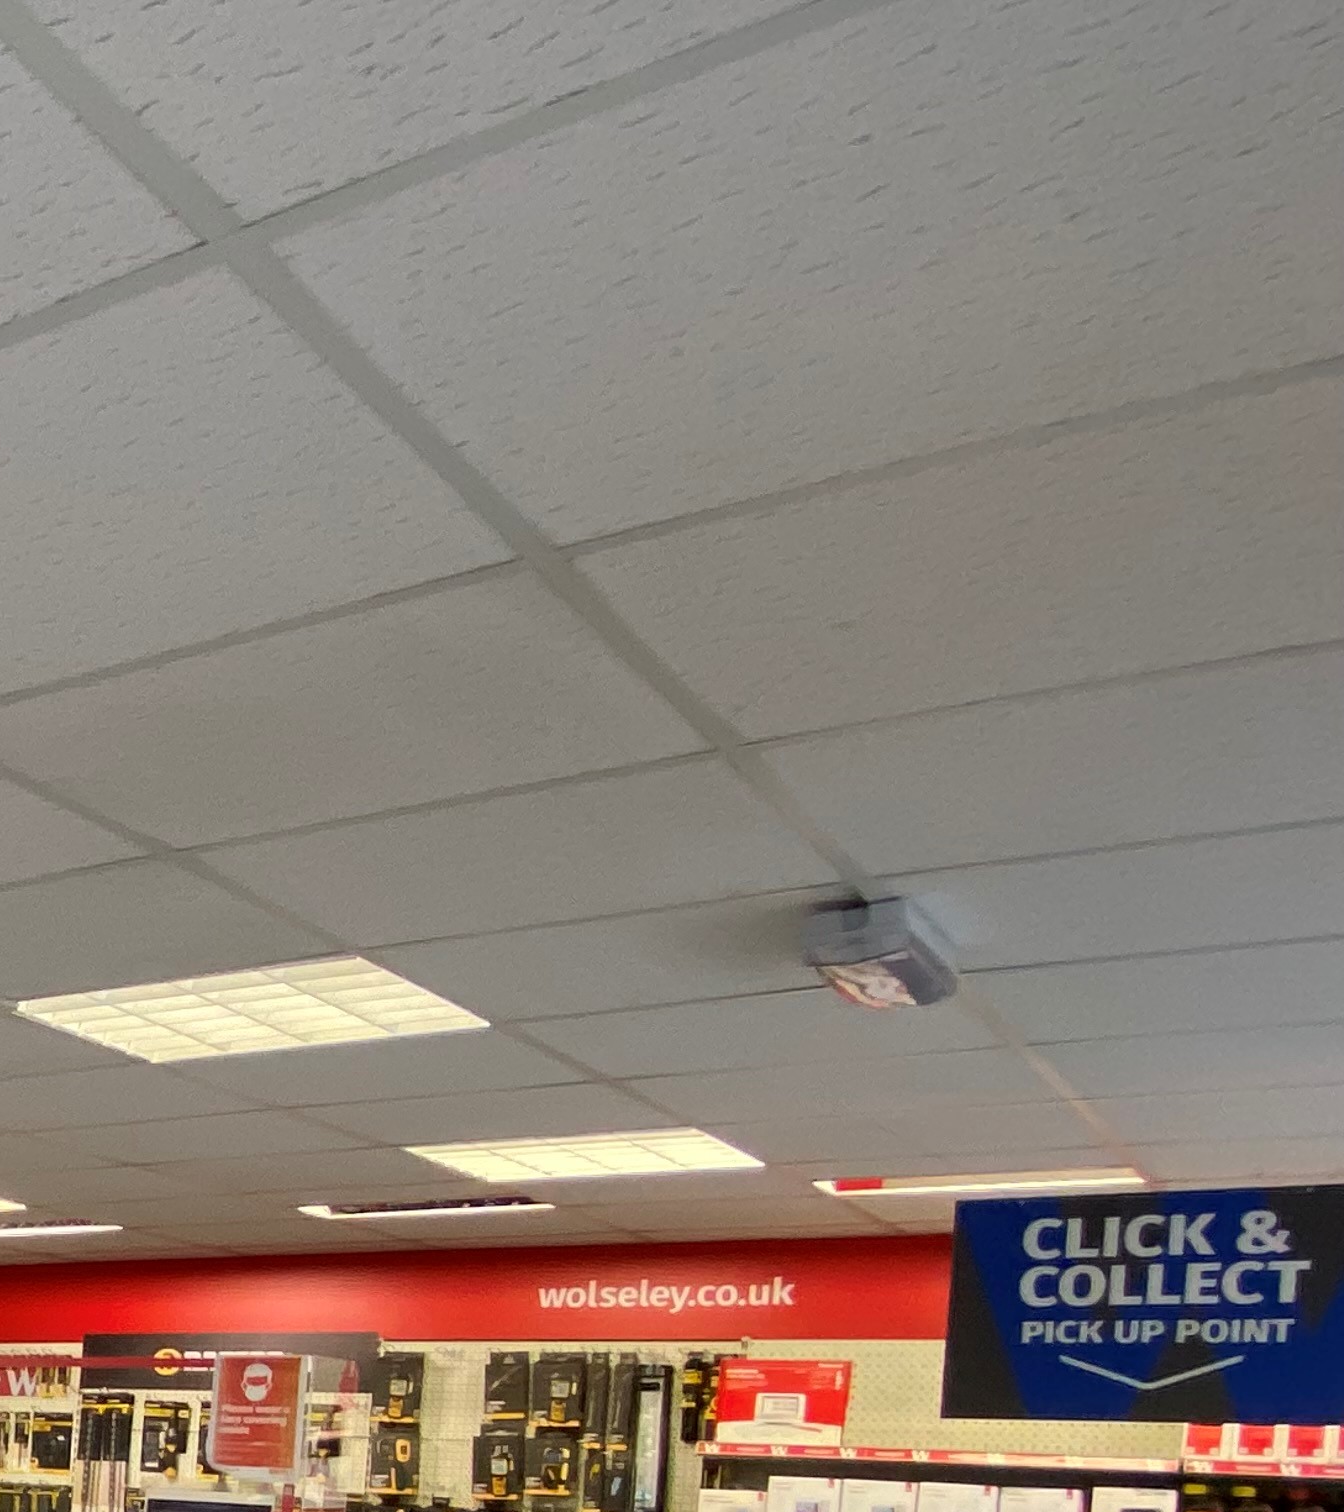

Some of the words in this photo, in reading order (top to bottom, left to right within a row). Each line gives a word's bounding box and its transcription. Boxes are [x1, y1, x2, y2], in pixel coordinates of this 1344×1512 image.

[1022, 1213, 1216, 1260] CLICK
[1236, 1210, 1292, 1254] &
[538, 1276, 795, 1314] wolseley.co.uk
[1019, 1260, 1311, 1307] COLLECT
[1021, 1320, 1104, 1345] PICK
[1113, 1319, 1165, 1344] UP
[1175, 1318, 1295, 1344] POINT
[6, 1369, 37, 1397] W
